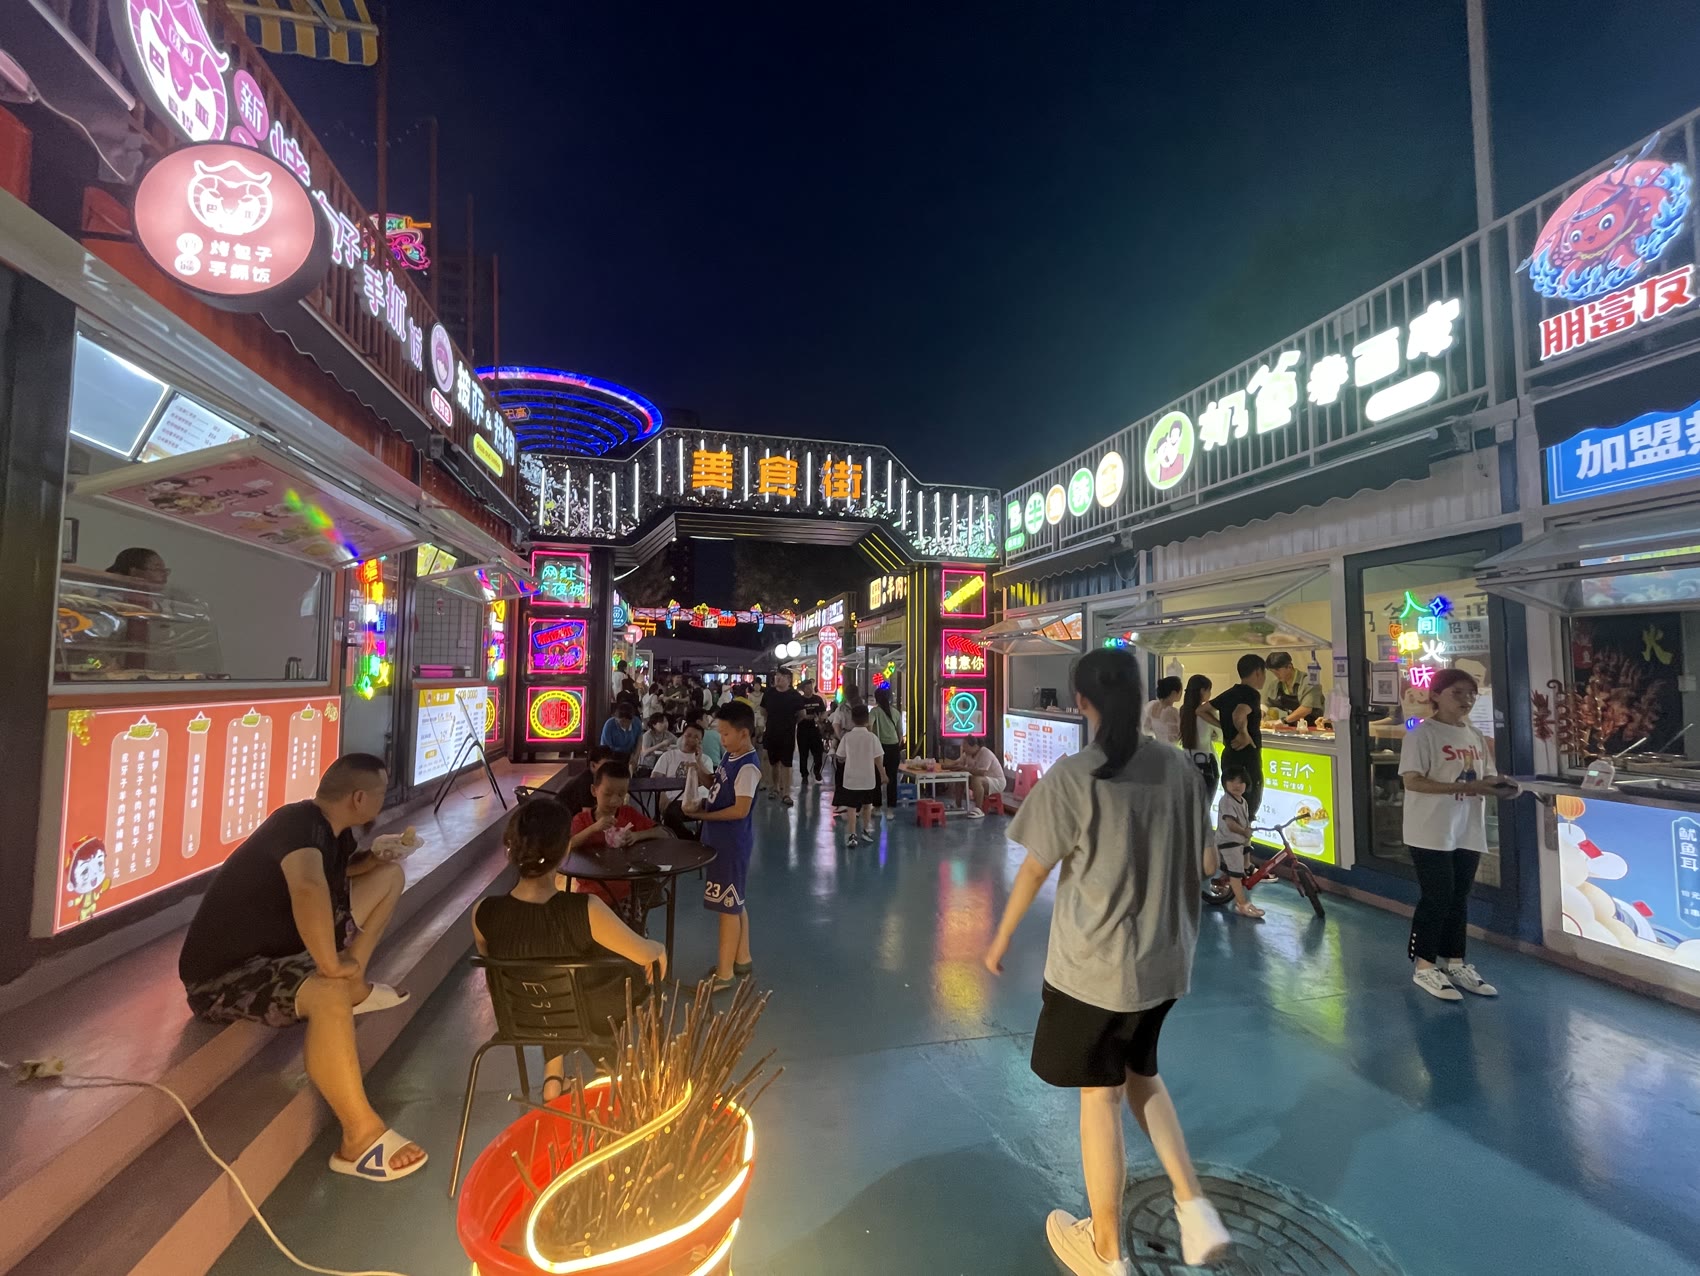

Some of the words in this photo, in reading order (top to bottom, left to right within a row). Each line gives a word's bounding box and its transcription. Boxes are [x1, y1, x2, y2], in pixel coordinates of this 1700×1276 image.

[209, 240, 272, 262] 烤包子
[1539, 264, 1696, 361] 朋富友
[1576, 409, 1700, 480] 加盟
[692, 449, 863, 500] 美食街
[1269, 760, 1315, 779] 8元/个
[1678, 826, 1699, 872] 鱿鱼耳
[705, 880, 721, 898] 23
